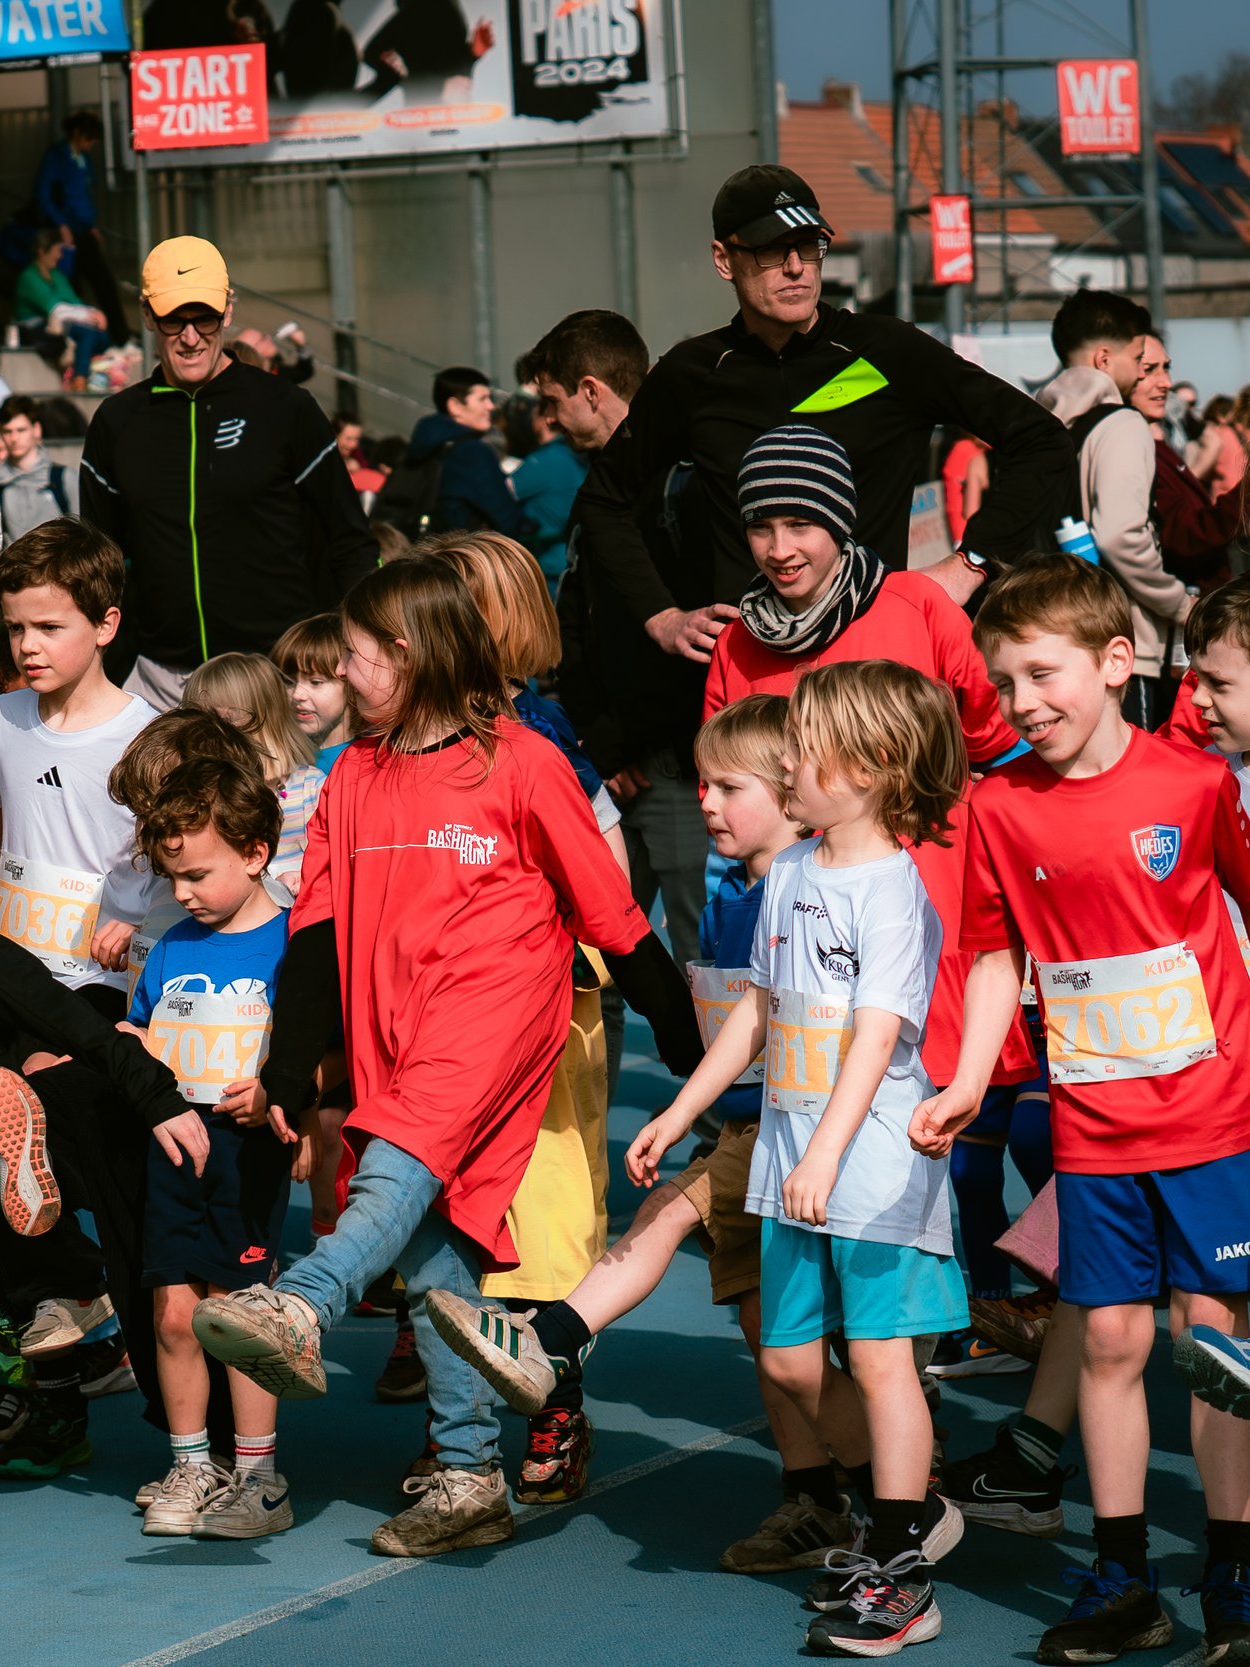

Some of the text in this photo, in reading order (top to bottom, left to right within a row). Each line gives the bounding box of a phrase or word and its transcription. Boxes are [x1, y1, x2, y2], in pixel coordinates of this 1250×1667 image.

[522, 0, 639, 64] PARIS
[137, 53, 252, 101] START
[534, 57, 630, 87] 2024
[1064, 65, 1132, 114] WC
[159, 101, 234, 136] ZONE
[934, 200, 967, 229] WC
[427, 829, 486, 852] BASHIR'S
[1140, 836, 1174, 856] HEDES
[459, 844, 487, 865] RUN
[60, 877, 95, 895] KIDS
[829, 959, 855, 978] KRC
[1144, 955, 1188, 977] KIDS
[727, 980, 751, 993] KI
[237, 1003, 271, 1017] KIDS
[808, 1005, 849, 1019] KIDS
[1050, 986, 1200, 1055] 7062
[154, 1027, 270, 1079] 7042
[768, 1028, 840, 1088] 011
